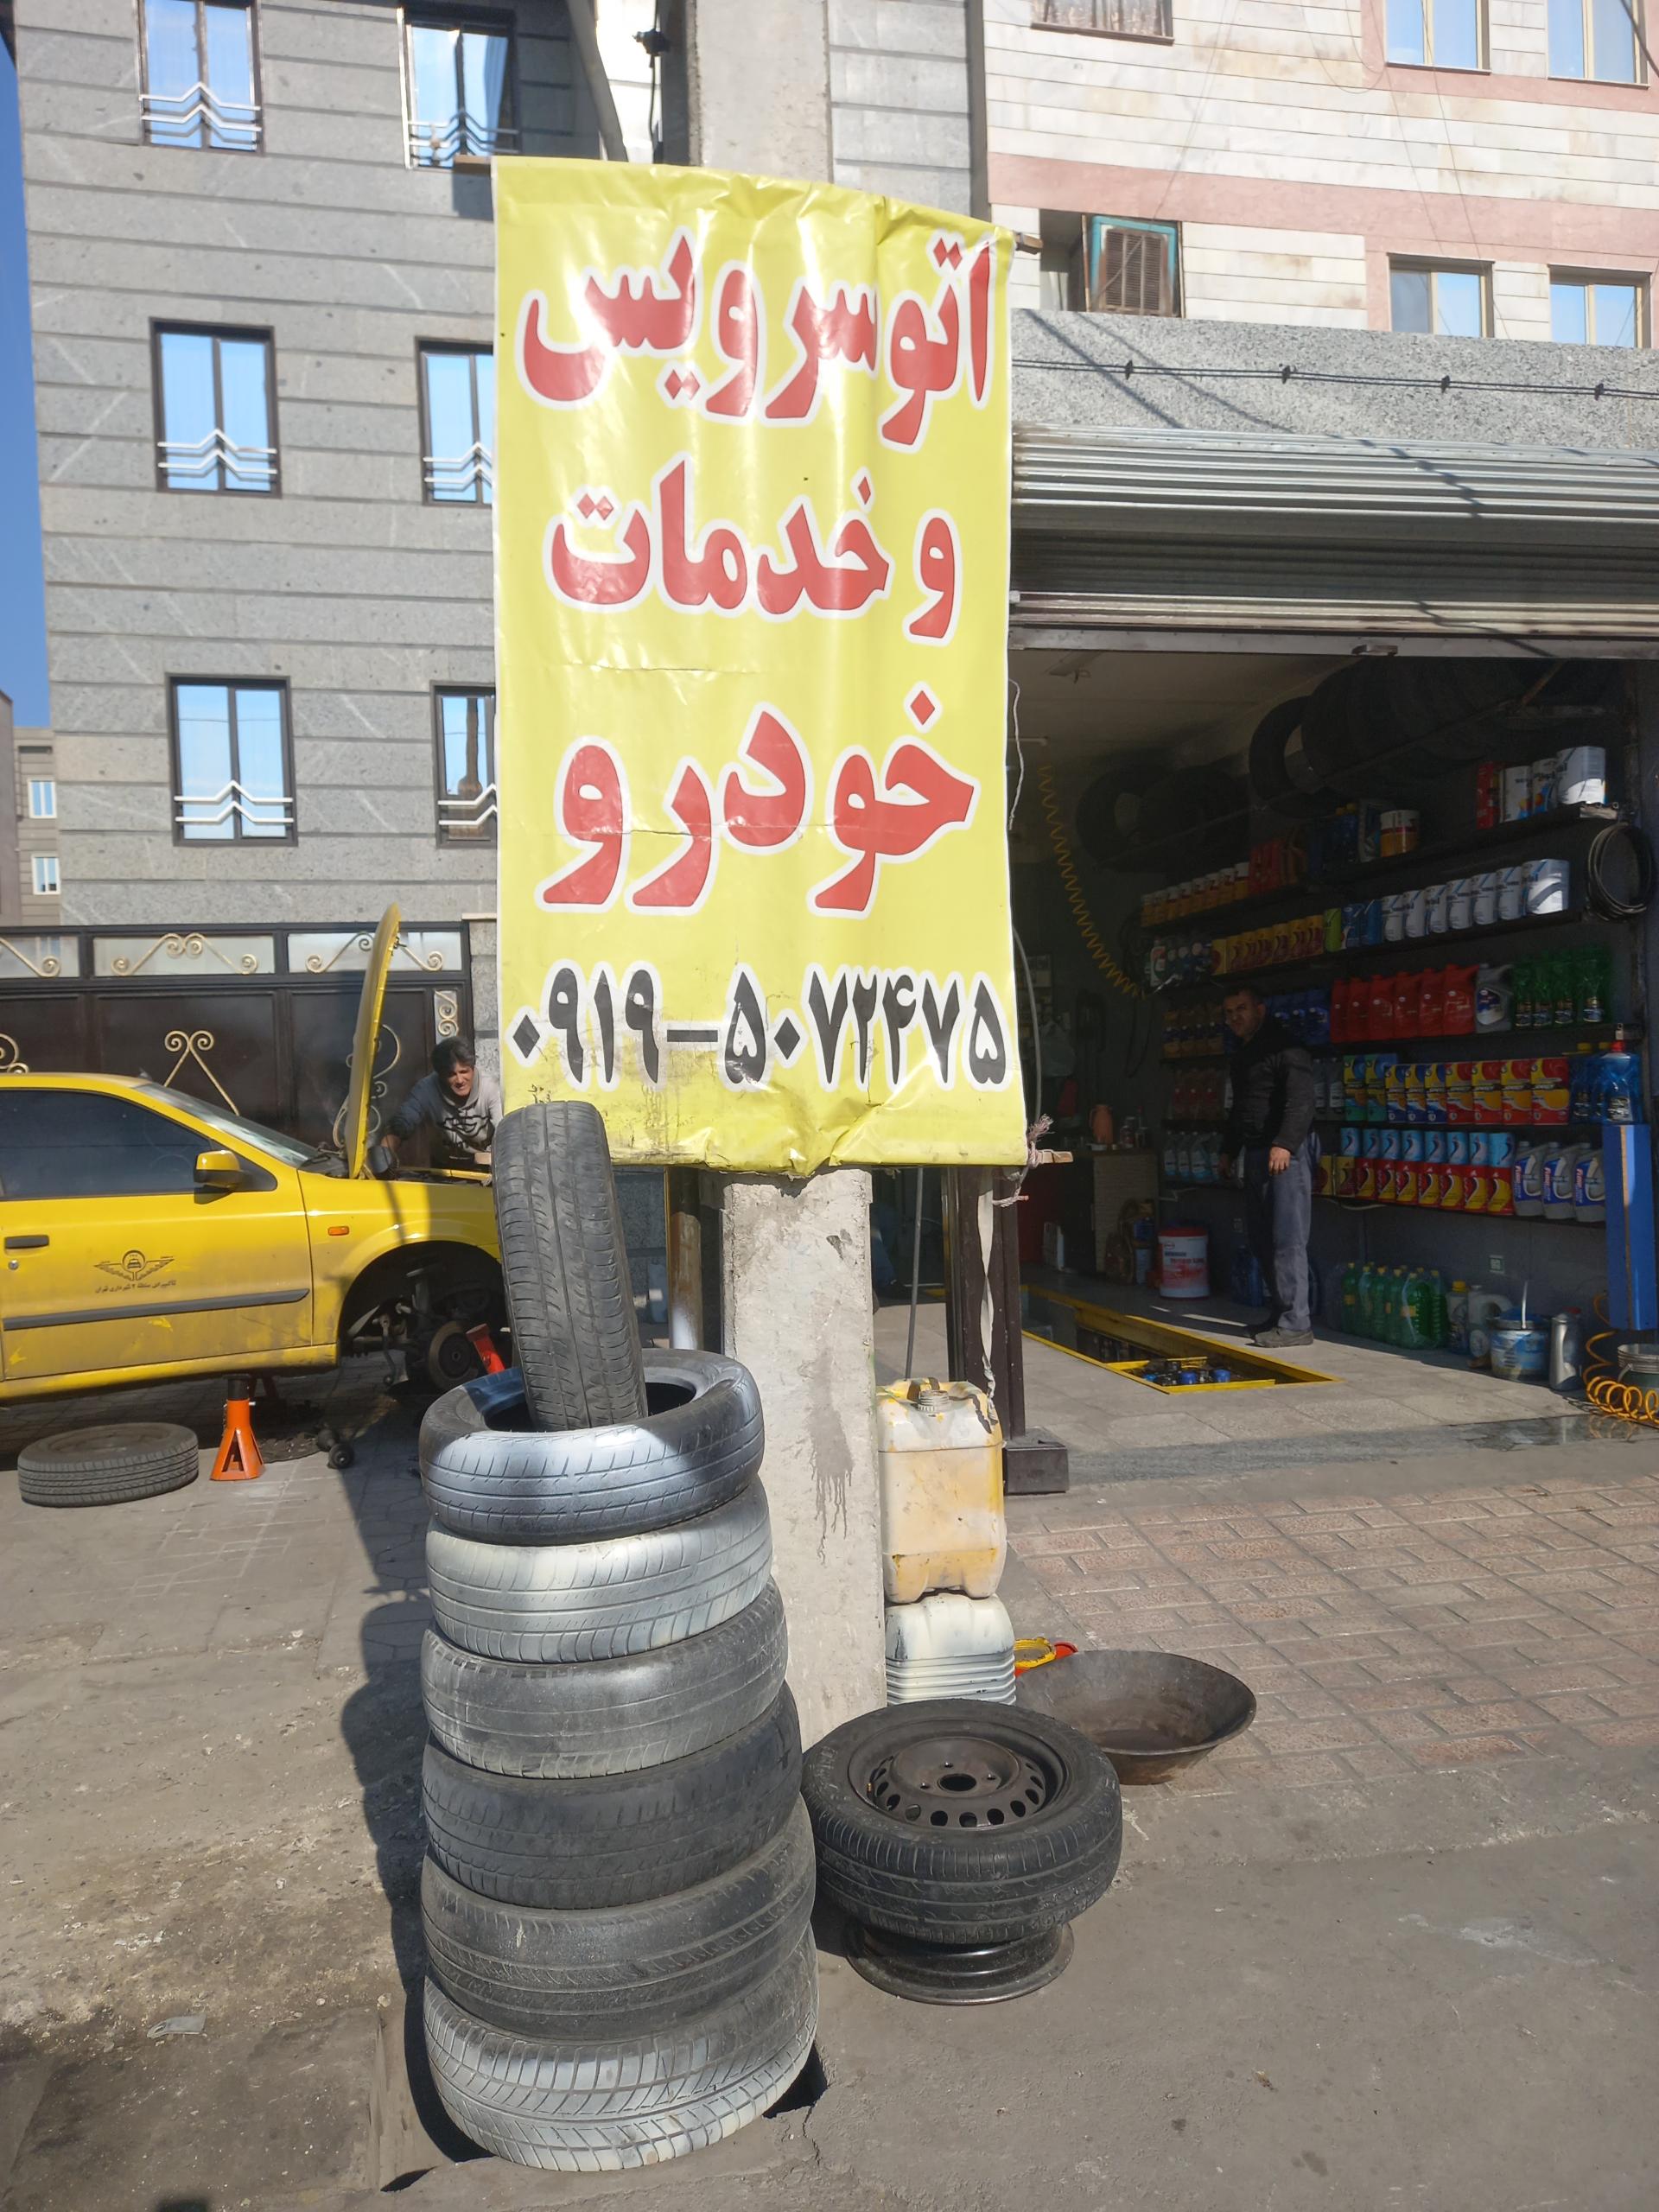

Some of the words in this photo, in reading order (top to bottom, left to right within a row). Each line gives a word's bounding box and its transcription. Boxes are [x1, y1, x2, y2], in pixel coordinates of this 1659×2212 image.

[550, 460, 890, 614] خدمات
[908, 517, 956, 639] و
[542, 690, 976, 912] خودرو
